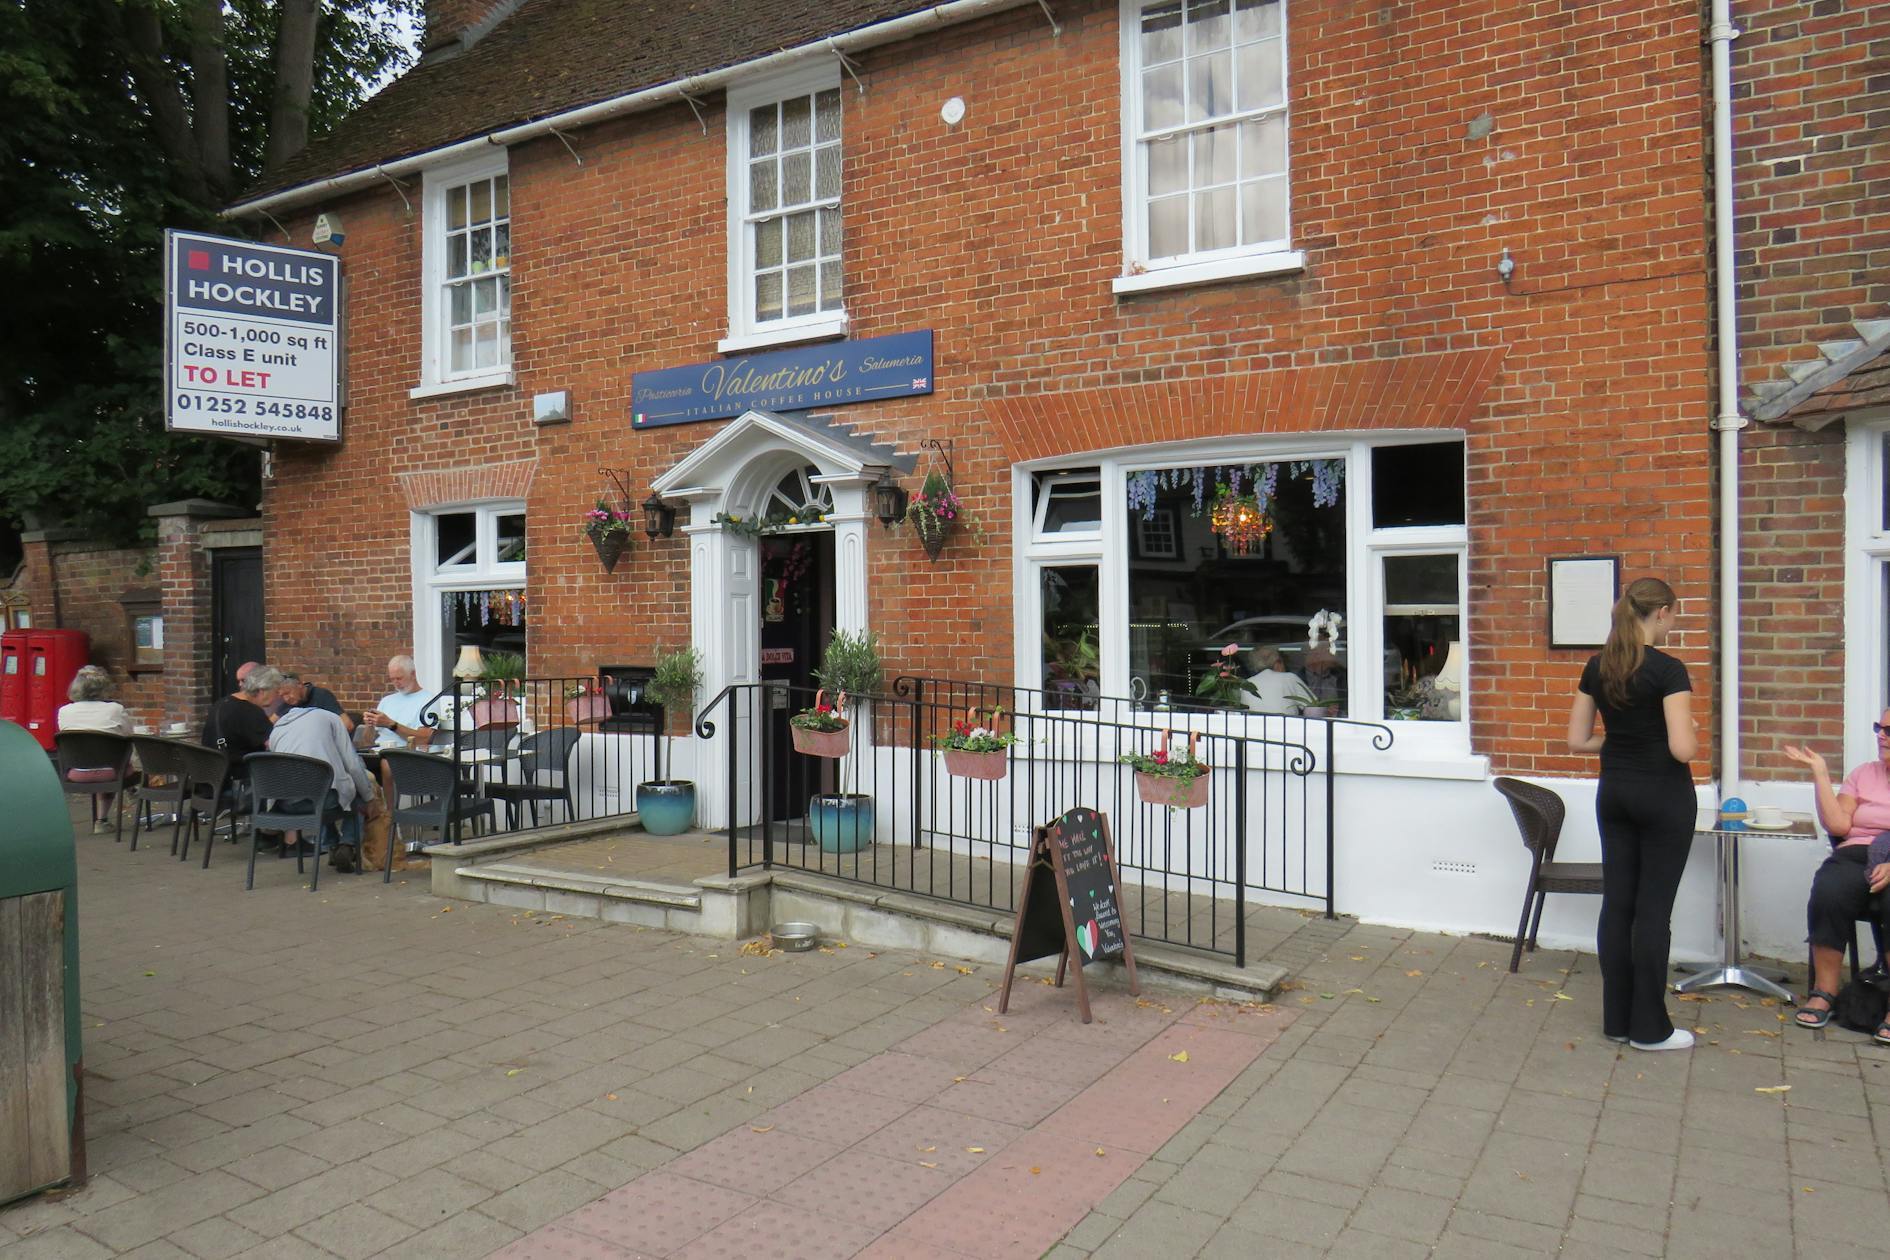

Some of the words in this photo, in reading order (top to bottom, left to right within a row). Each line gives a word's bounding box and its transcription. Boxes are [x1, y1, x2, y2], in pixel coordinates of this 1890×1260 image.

[222, 254, 324, 286] HOLLIS
[188, 279, 323, 314] HOCKLEY
[184, 321, 281, 344] 500-1,000
[287, 335, 308, 350] sq
[314, 336, 328, 350] ft
[184, 342, 236, 360] Class
[243, 348, 255, 362] E
[262, 351, 297, 367] unit
[859, 354, 924, 373] Salumeria
[184, 365, 218, 384] TO
[226, 369, 271, 389] LET
[702, 359, 847, 401] Valentino's
[177, 394, 247, 414] 01252
[255, 401, 333, 422] 545848
[687, 402, 742, 416] ITALIAN
[751, 395, 804, 408] COFFEE
[814, 387, 862, 400] HOUSE
[211, 418, 303, 433] hollishockley.co.uk
